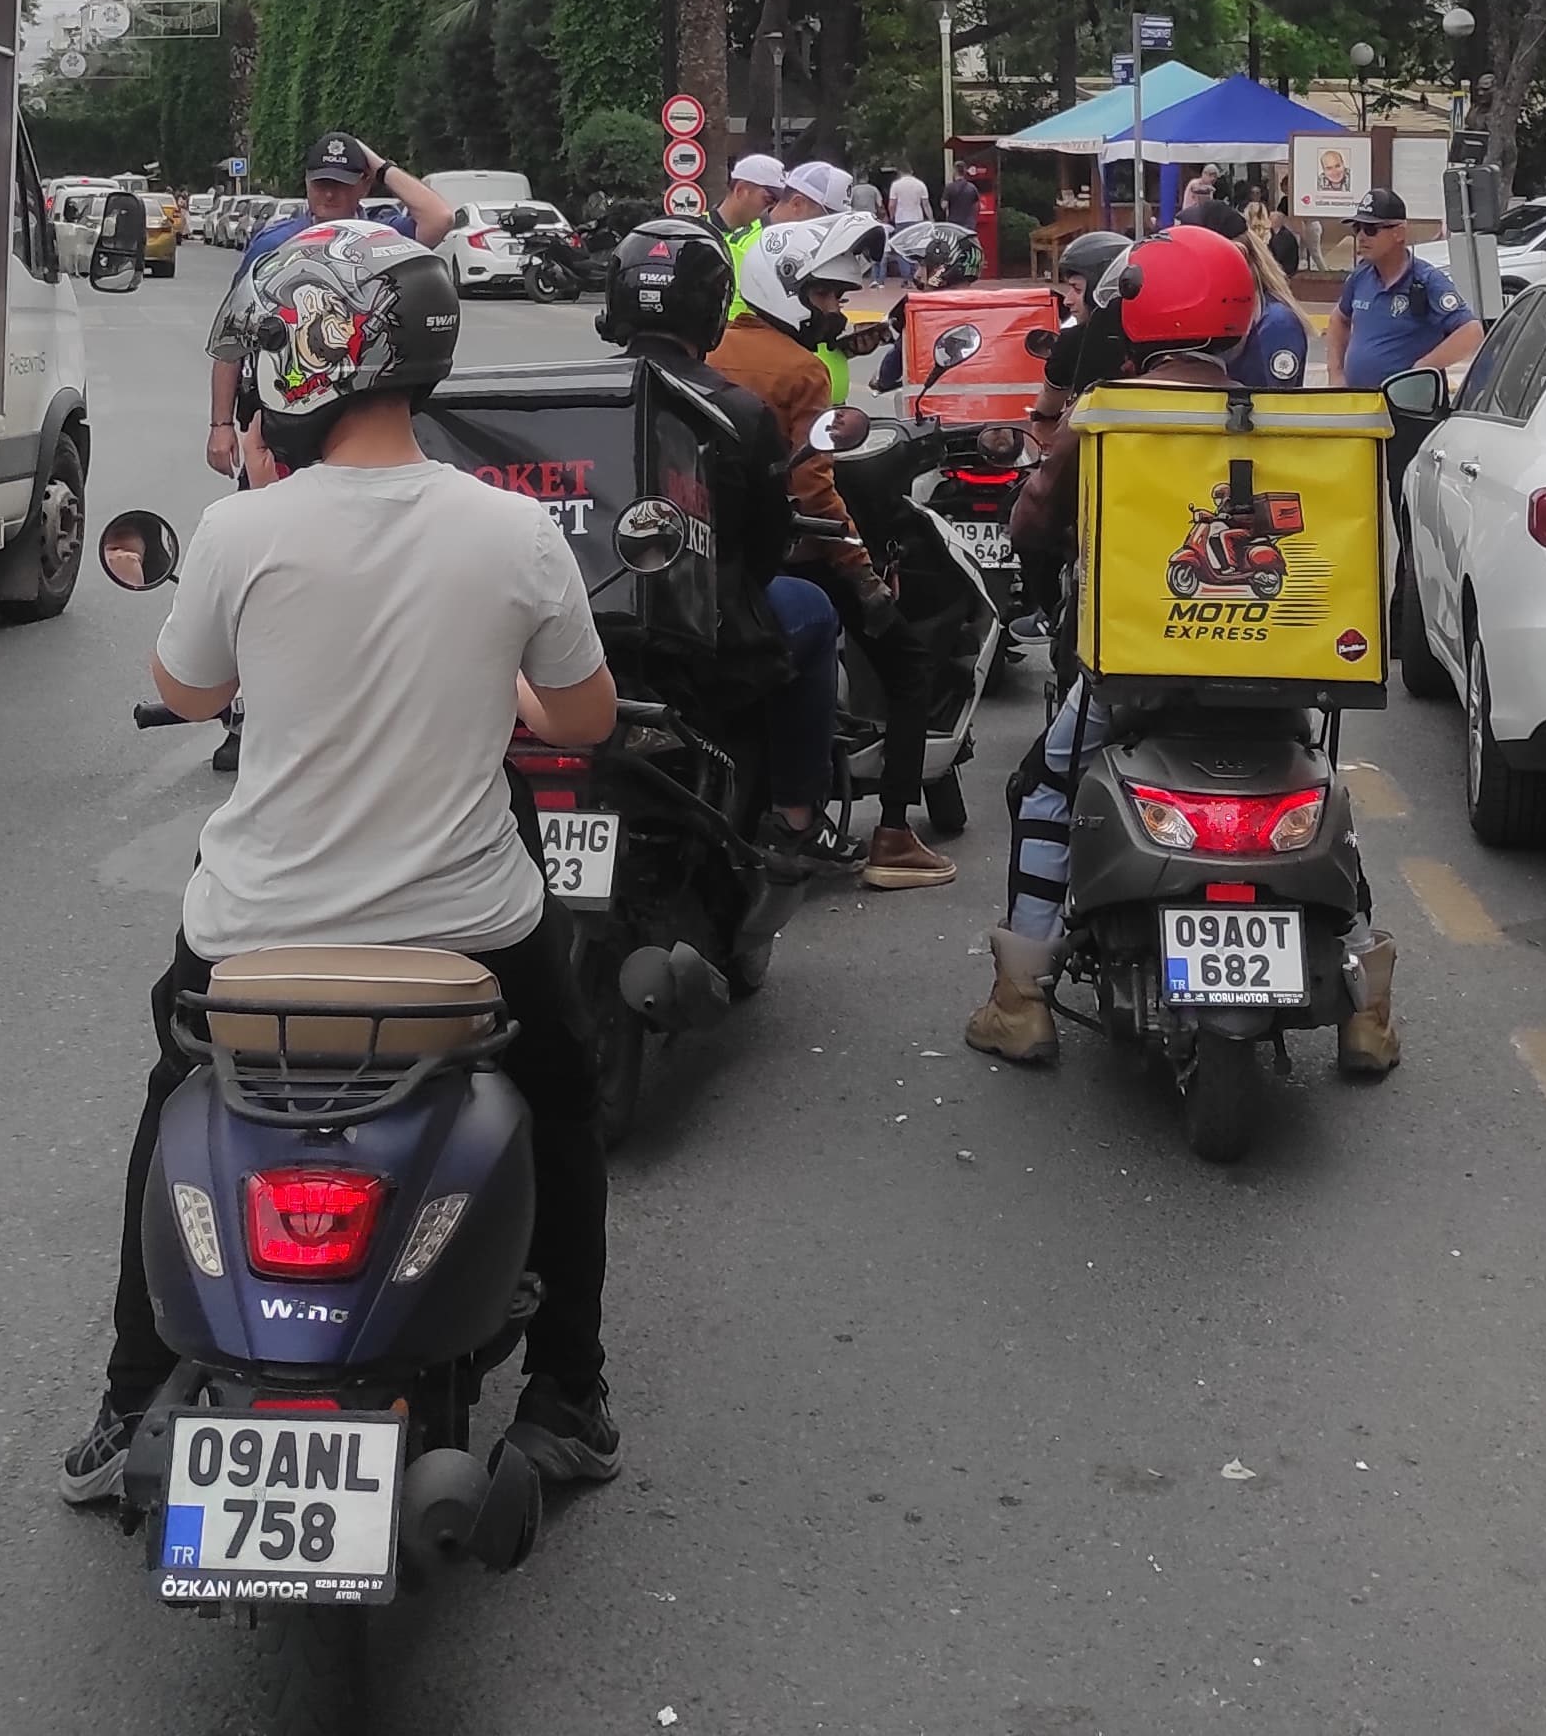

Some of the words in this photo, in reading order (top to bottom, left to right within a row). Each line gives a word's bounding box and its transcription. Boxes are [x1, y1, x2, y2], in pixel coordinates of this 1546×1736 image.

[1168, 602, 1269, 623] MOTO
[1164, 625, 1269, 641] EXPRESS
[1172, 979, 1186, 990] TR
[1201, 954, 1271, 987] 682
[1209, 992, 1234, 1003] KORU
[1236, 992, 1269, 1003] MOTOR
[188, 1427, 380, 1493] 09ANL
[171, 1546, 194, 1564] TR
[223, 1498, 336, 1563] 758
[161, 1575, 230, 1598] ÖZKAN
[235, 1580, 309, 1600] MOTOR
